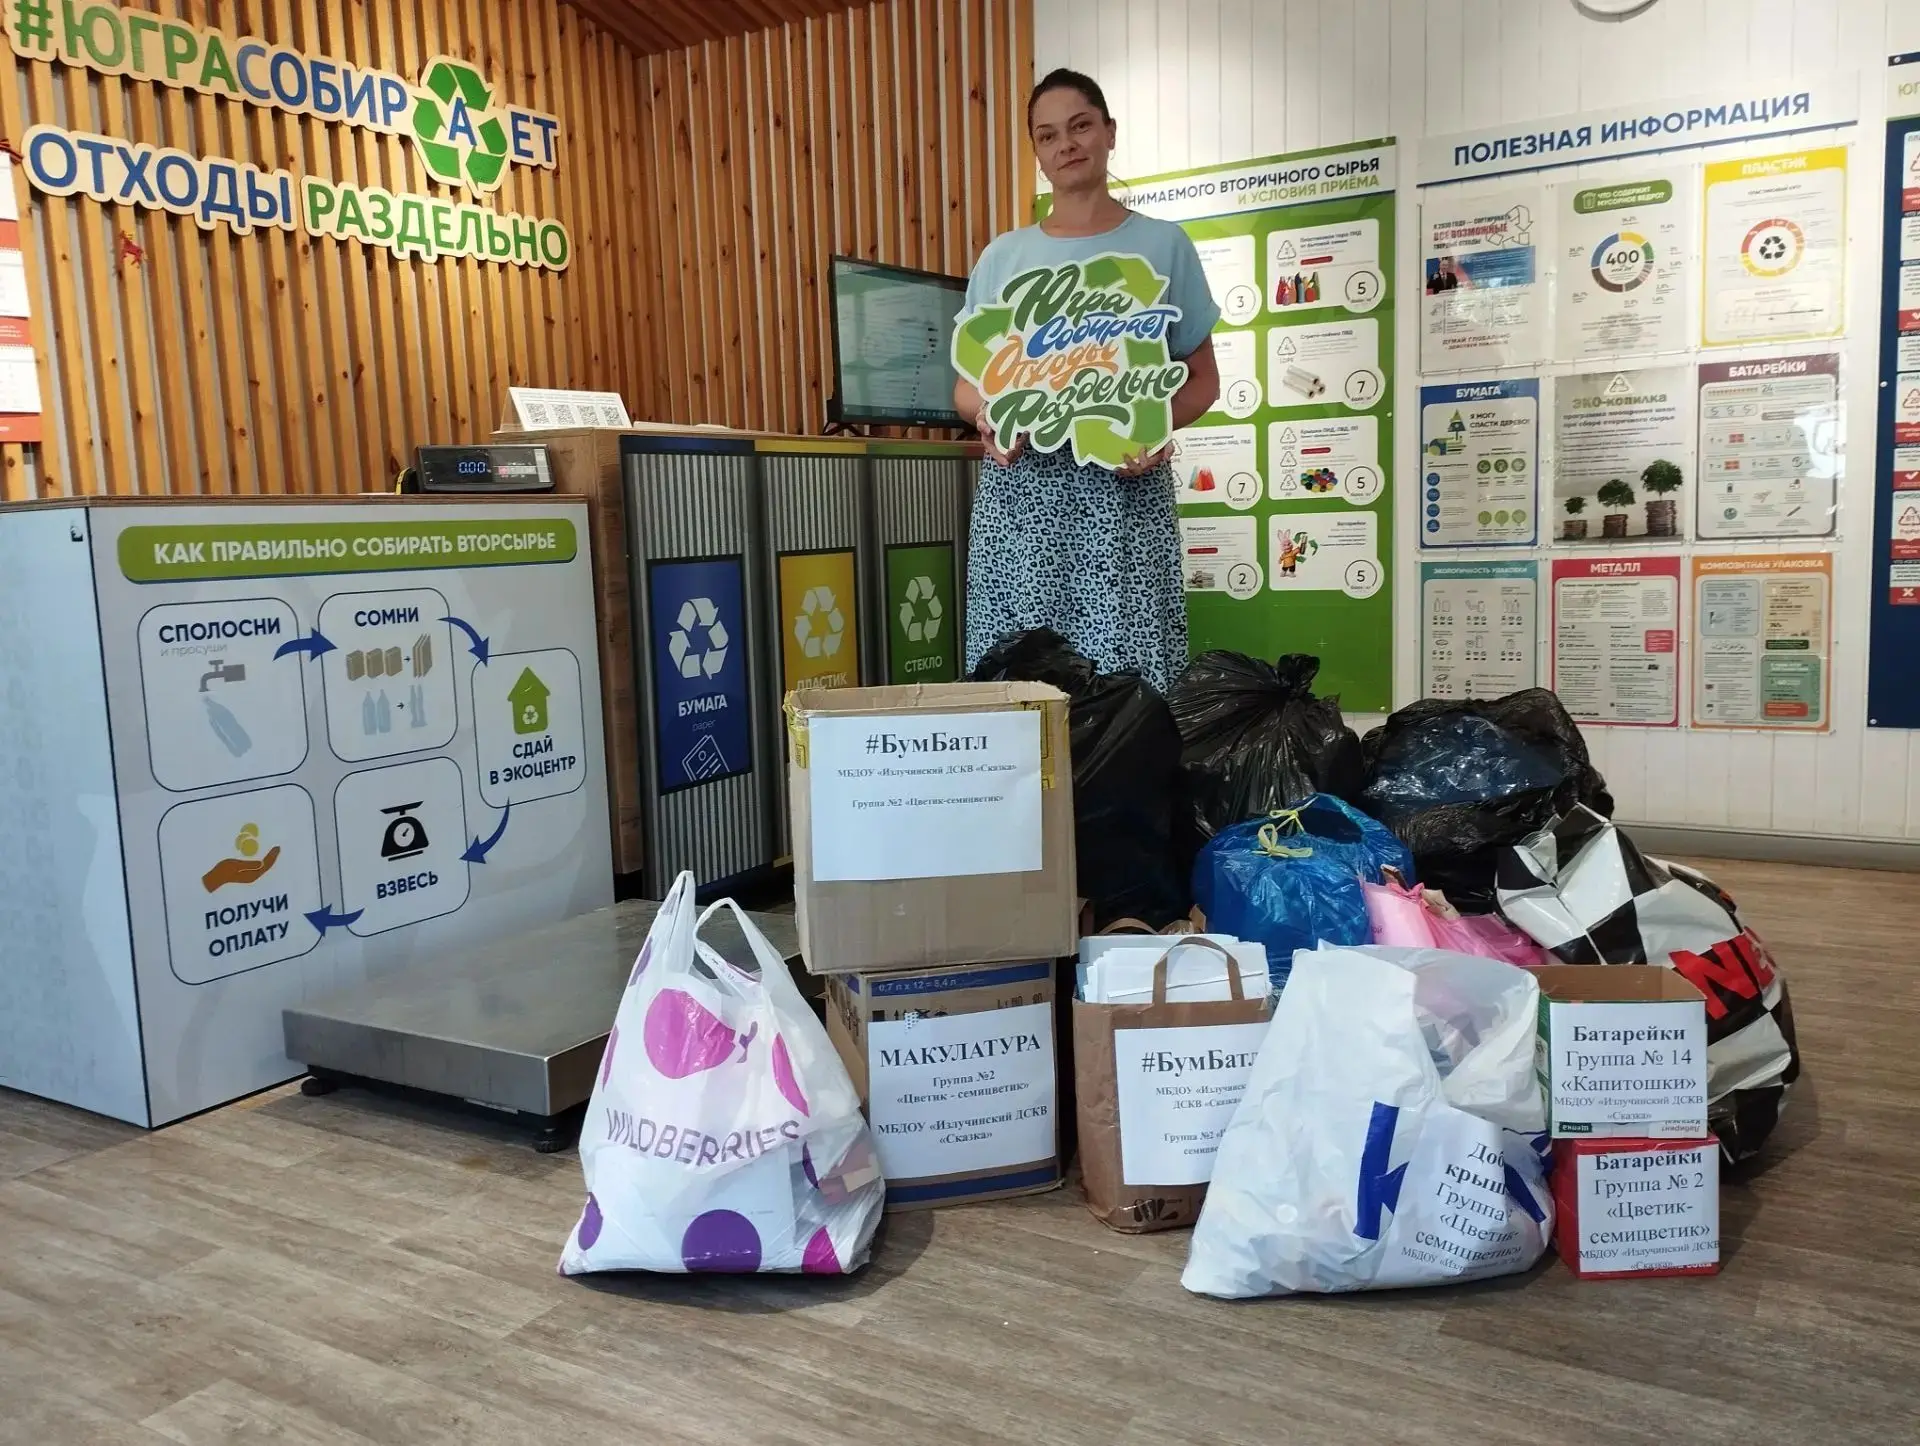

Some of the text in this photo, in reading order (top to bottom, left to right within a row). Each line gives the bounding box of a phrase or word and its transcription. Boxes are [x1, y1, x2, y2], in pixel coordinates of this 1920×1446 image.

[1454, 93, 1810, 166] ПОЛЕЗНАЯ ИНФОРМАЦИЯ
[1742, 156, 1808, 175] ПЛАСТИК
[1220, 166, 1320, 194] ВТОРИЧНОГО
[1324, 157, 1379, 178] СЫРЬЯ
[28, 131, 569, 267] ОТХОДЫ РАЗДЕЛЬНО
[1238, 175, 1379, 206] И УСЛОВИЯ ПРИЁМА
[1606, 250, 1640, 265] 400
[1002, 263, 1133, 332] Югра
[1357, 282, 1366, 295] 5
[1237, 295, 1244, 308] 3
[1026, 309, 1182, 359] Собирает
[983, 335, 1119, 395] Отходы
[1728, 360, 1806, 378] БАТАРЕЙКИ
[1238, 390, 1246, 402] 5
[1357, 381, 1366, 394] 7
[1456, 385, 1501, 399] БУМАГА
[990, 365, 1185, 449] Раздельно
[459, 461, 486, 474] 0.00
[1238, 482, 1246, 495] 7
[1357, 477, 1366, 489] 5
[154, 532, 556, 565] КАК ПРАВИЛЬНО СОБИРАТЬ ВТОРСЫРЬЕ
[1357, 570, 1366, 582] 5
[1590, 563, 1641, 573] МЕТАЛЛ
[1238, 572, 1247, 585] 2
[354, 606, 420, 628] СОМНИ
[158, 617, 281, 644] СПОЛОСНИ
[170, 642, 229, 658] просуши
[904, 655, 943, 673] СТЕКЛО
[678, 694, 728, 717] БУМАГА
[512, 736, 553, 760] СДАЙ
[866, 731, 989, 759] #БумБатл
[490, 756, 577, 785] В ЭКОЦЕНТР
[837, 768, 875, 778] МБДОУ
[945, 764, 974, 775] ДСКВ
[975, 762, 1017, 773] «Сказка»
[852, 798, 885, 809] Группа
[887, 797, 903, 807] №2
[376, 871, 439, 899] ВЗВЕСЬ
[204, 893, 289, 930] ПОЛУЧИ
[208, 921, 290, 957] ОПЛАТУ
[1572, 1025, 1686, 1044] Батарейки
[879, 1033, 1041, 1068] МАКУЛАТУРА
[1565, 1049, 1692, 1070] Группа № 14
[932, 1070, 995, 1089] Группа №2
[1561, 1075, 1697, 1092] «Капитошки»
[896, 1090, 948, 1105] «Цветик
[957, 1081, 1030, 1100] семицветик»
[1554, 1096, 1704, 1107] МБДОУ «Излучинский ДСКВ
[1172, 1099, 1202, 1110] ДСКВ
[877, 1105, 1048, 1136] МБДОУ «Излучинский ДСКВ
[1607, 1111, 1652, 1120] «Сказка»
[606, 1107, 800, 1166] WILDBERRIES
[939, 1131, 993, 1145] «Сказка»
[1163, 1132, 1198, 1143] Группа
[1595, 1151, 1702, 1171] Батарейки
[1594, 1172, 1705, 1198] Группа № 2
[1435, 1182, 1506, 1222] Группа
[1607, 1201, 1693, 1220] «Цветик-
[1589, 1225, 1710, 1245] семицветик»
[1401, 1246, 1438, 1264] МБДОУ
[1415, 1231, 1522, 1262] семицветик»
[1578, 1241, 1720, 1260] МБДОУ «Излучинский ДСКВ
